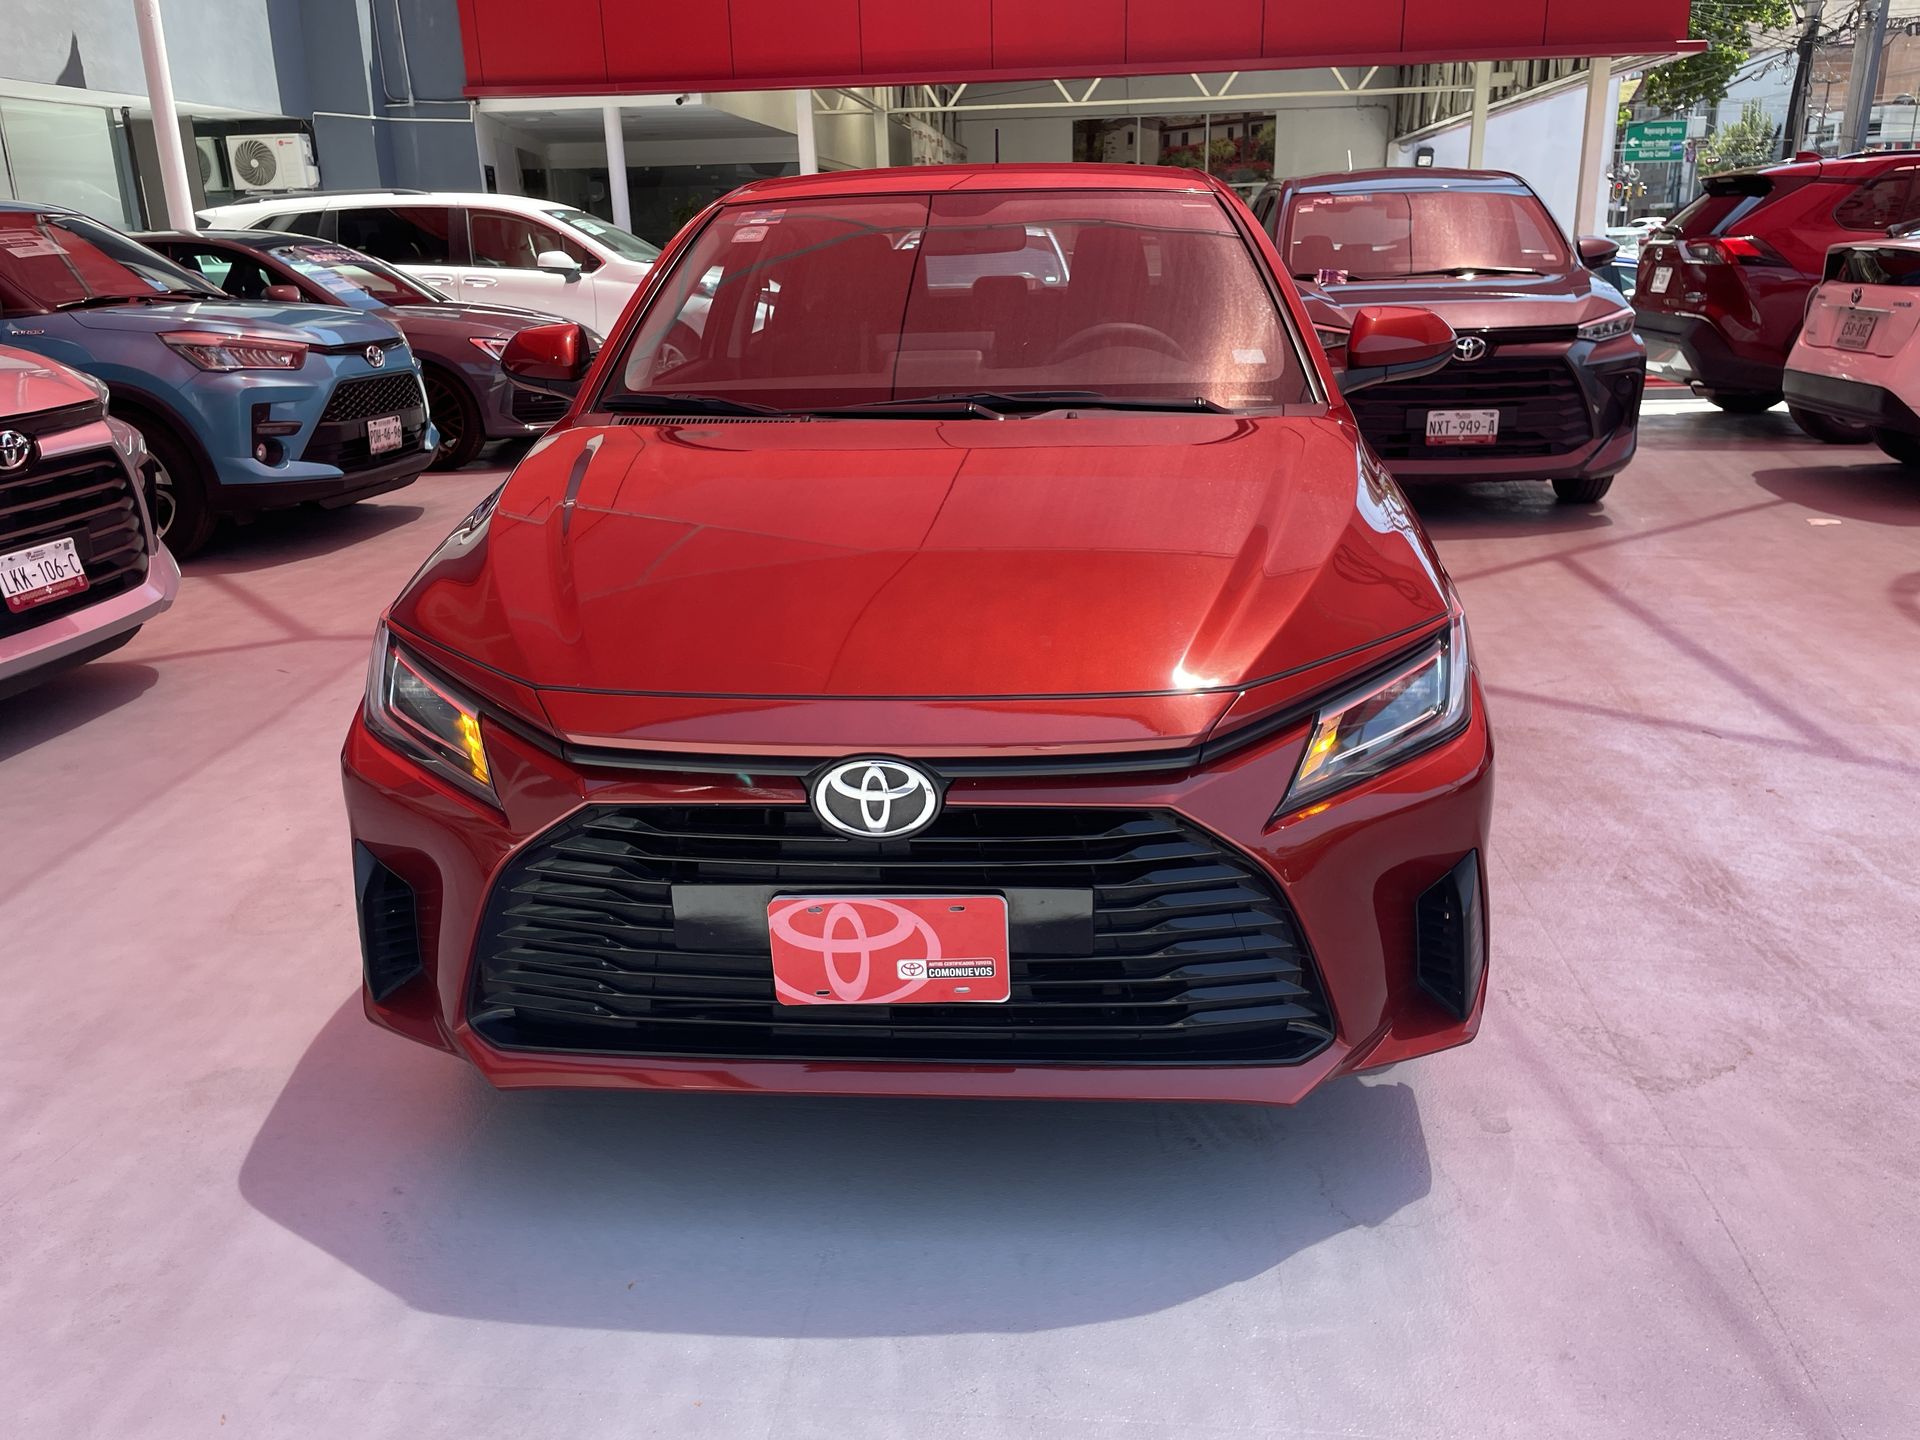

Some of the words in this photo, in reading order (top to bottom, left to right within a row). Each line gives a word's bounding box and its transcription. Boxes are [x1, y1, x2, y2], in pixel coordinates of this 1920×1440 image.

[1428, 419, 1495, 436] NXT-949-A
[0, 553, 81, 595] LKK-106-C
[928, 967, 993, 978] COMONUEVOS
